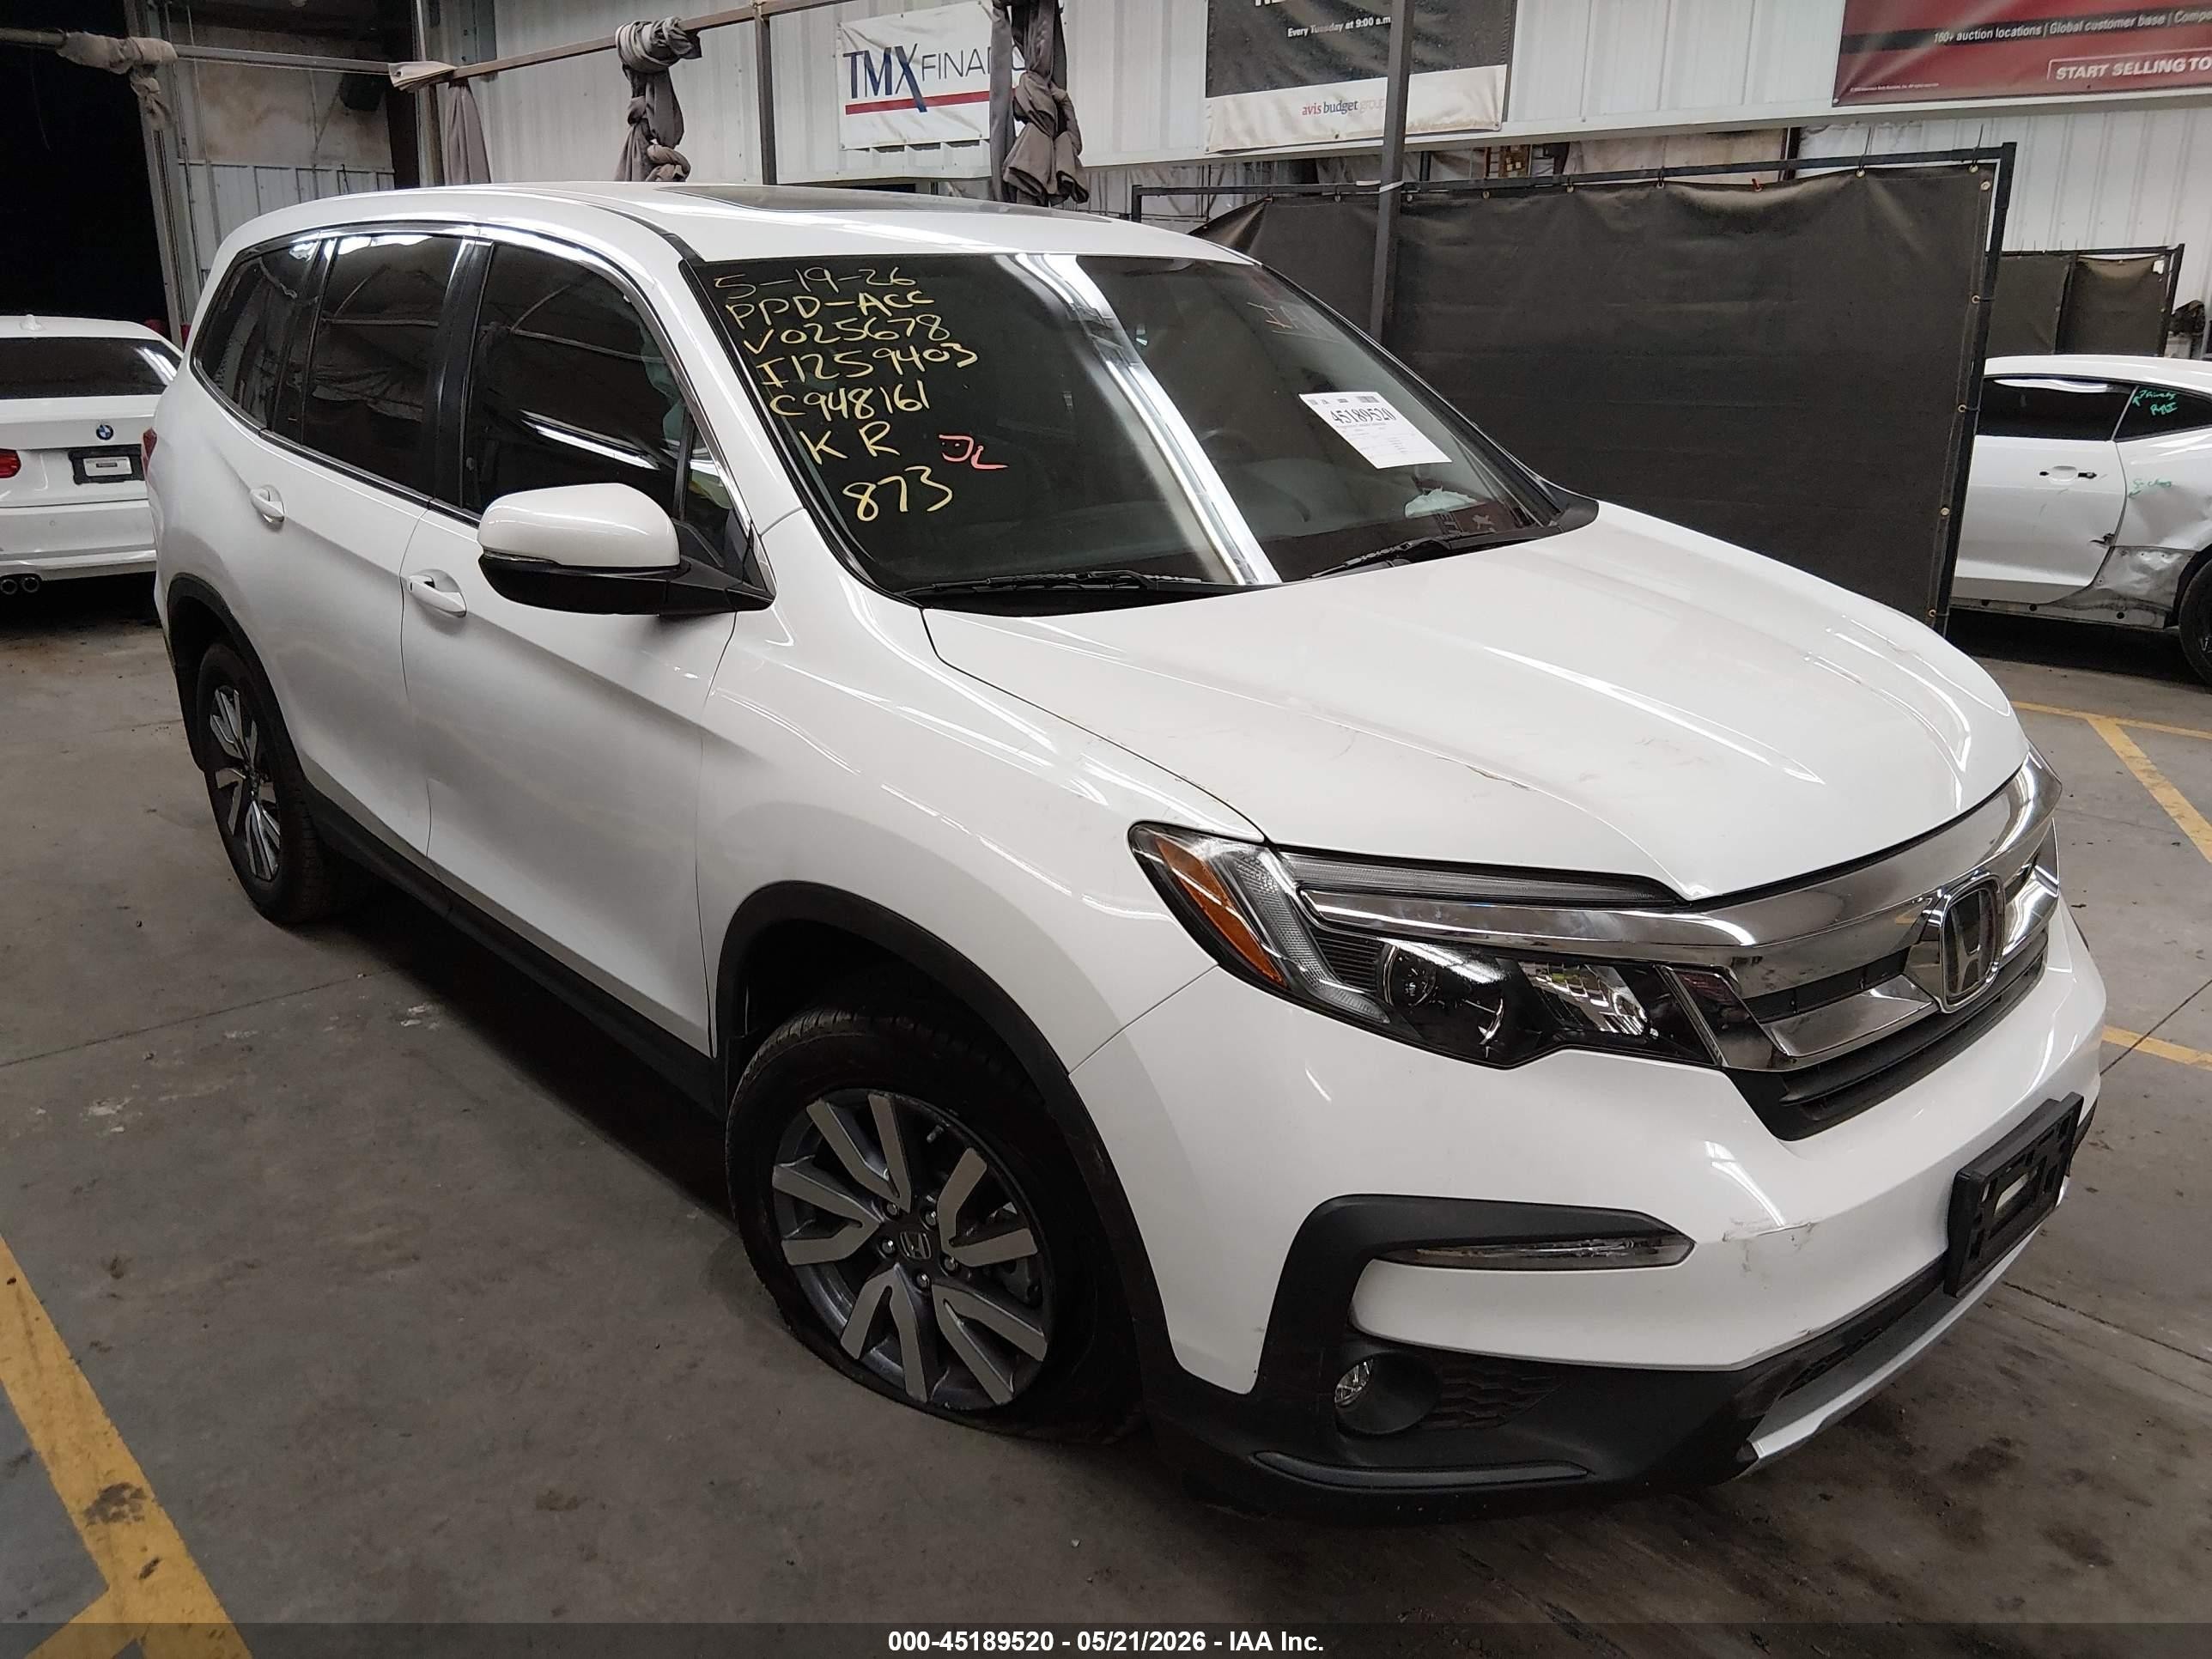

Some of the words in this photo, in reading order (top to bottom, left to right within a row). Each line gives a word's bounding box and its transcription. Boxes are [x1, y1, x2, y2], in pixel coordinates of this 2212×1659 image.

[1287, 27, 1309, 38] Every
[1345, 21, 1354, 30] at
[1355, 16, 1374, 28] 9:00
[1956, 29, 1993, 41] auction
[1996, 25, 2042, 39] locations
[2049, 20, 2083, 34] Global
[2084, 15, 2136, 31] customer
[2136, 13, 2165, 27] base
[842, 43, 928, 112] TMX
[2056, 64, 2110, 80] START
[2112, 58, 2186, 76] SELLING
[1302, 103, 1322, 115] avis
[1323, 100, 1358, 114] budget
[714, 266, 917, 300] 5-19-26
[726, 290, 935, 329] PPD-ACC
[744, 313, 951, 356] V025678
[769, 379, 932, 422] C948161
[1329, 407, 1397, 425] 45189520
[842, 465, 953, 522] 873
